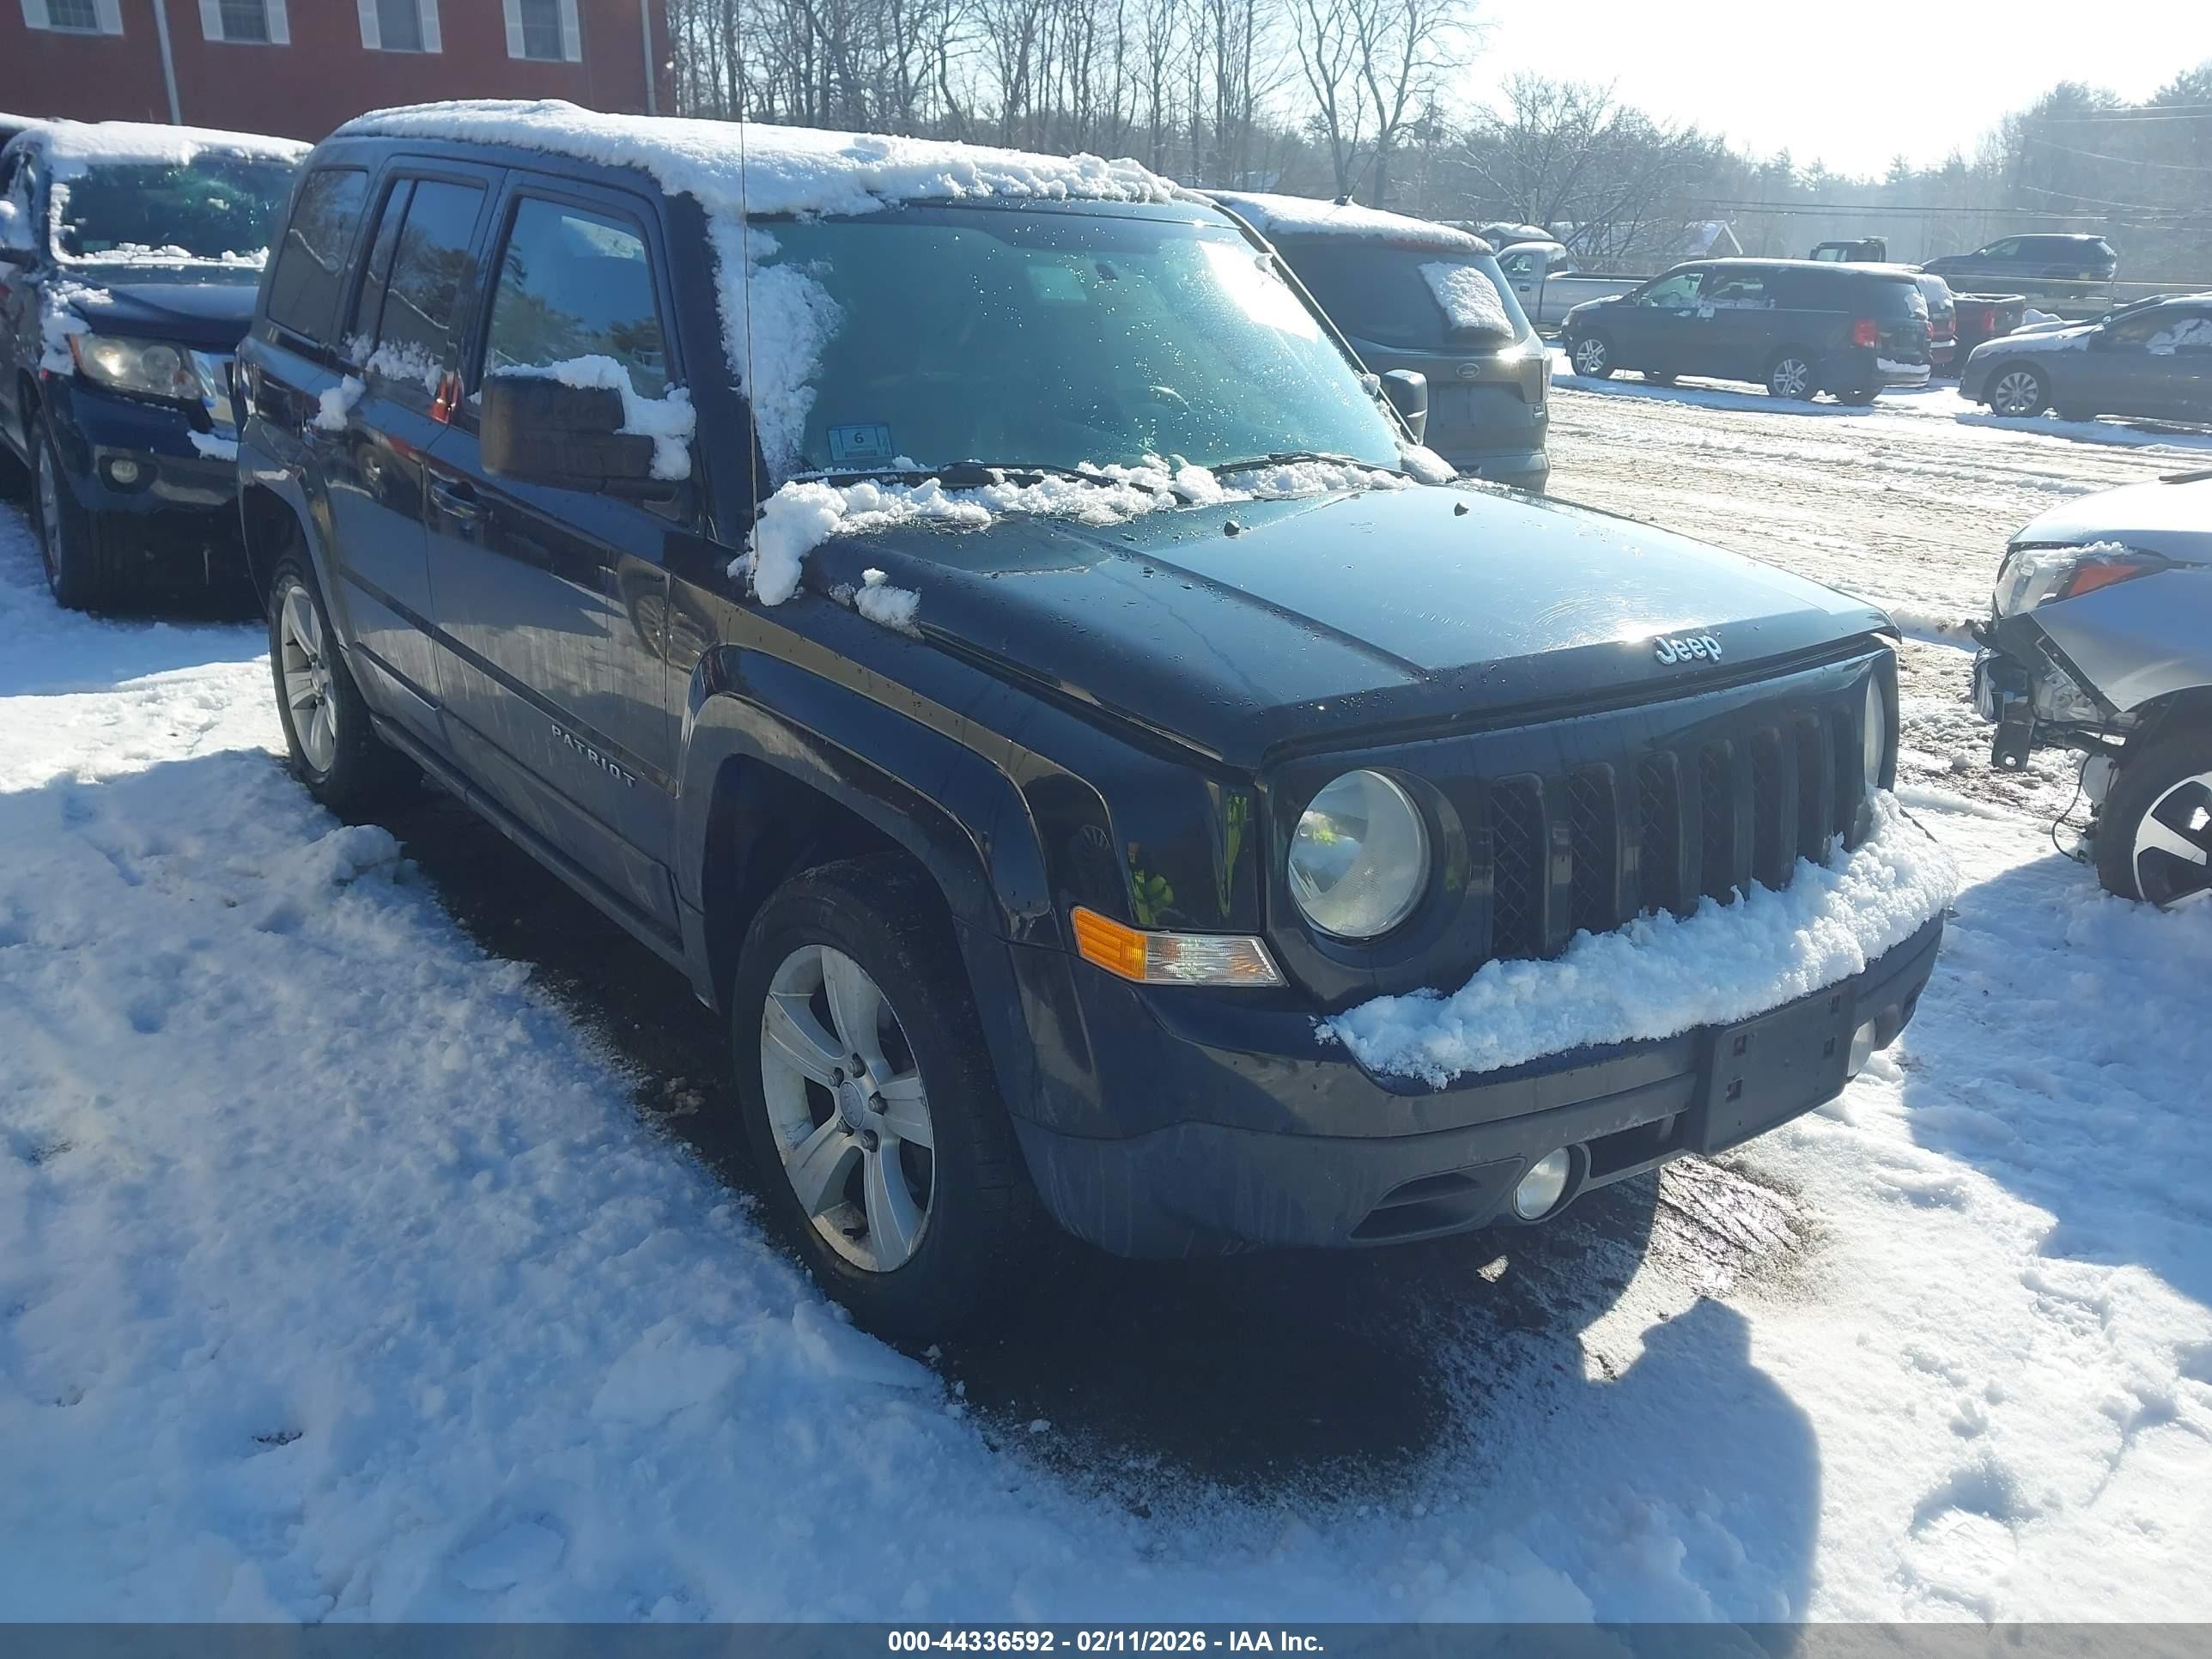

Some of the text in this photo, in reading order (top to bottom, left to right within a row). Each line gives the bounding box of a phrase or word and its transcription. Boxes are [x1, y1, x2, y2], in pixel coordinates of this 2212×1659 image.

[854, 432, 865, 444] 6
[1654, 635, 1723, 665] Jeep
[551, 724, 636, 788] PATRIOT
